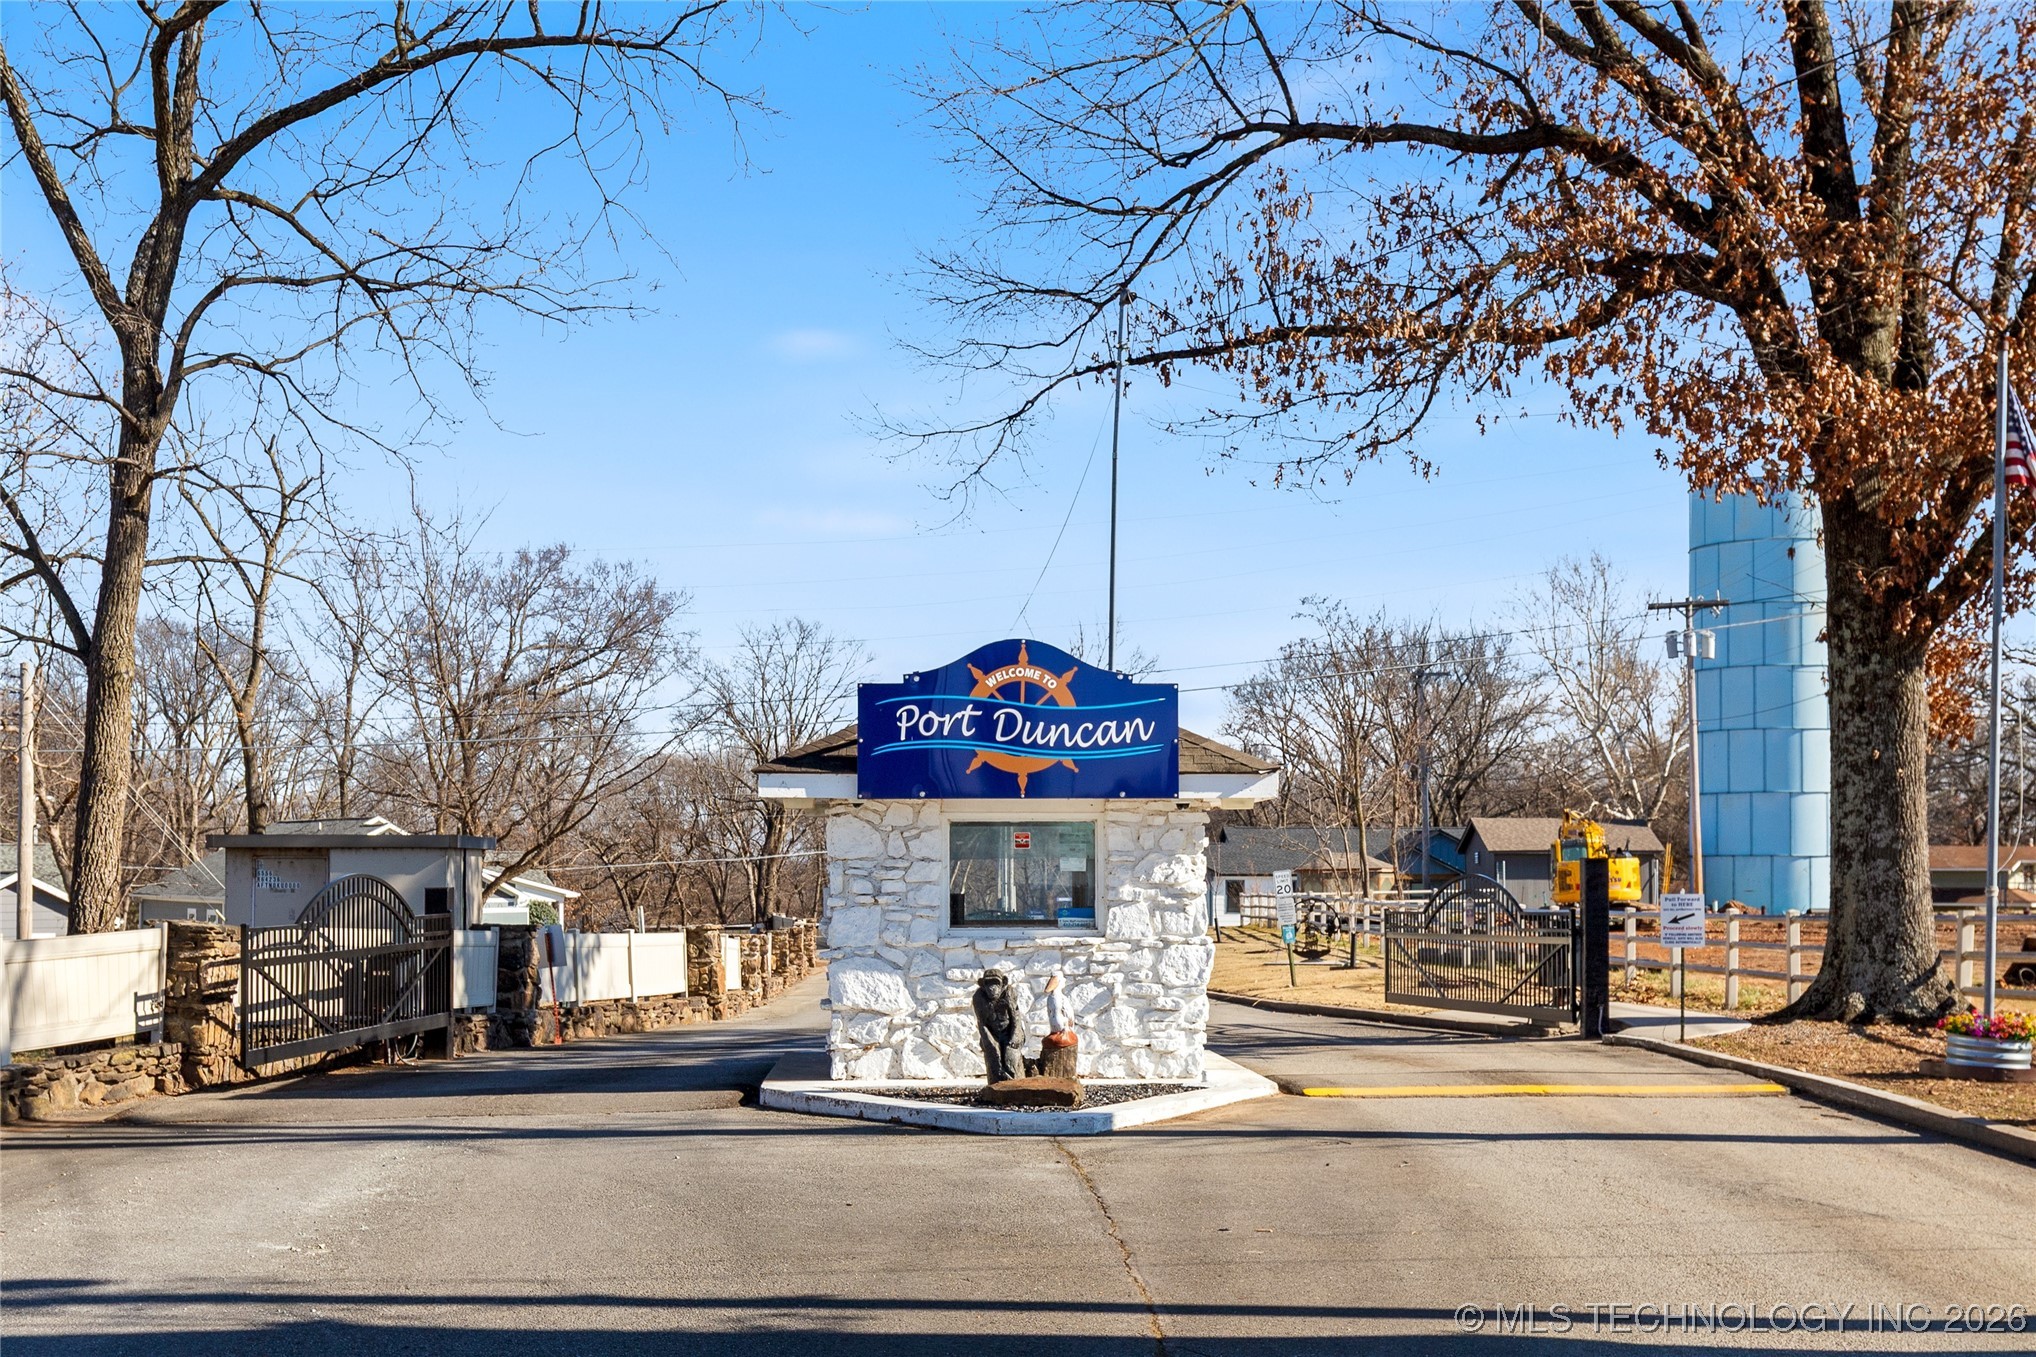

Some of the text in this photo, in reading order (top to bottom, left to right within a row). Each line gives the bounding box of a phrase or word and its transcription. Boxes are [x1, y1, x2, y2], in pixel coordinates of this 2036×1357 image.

[985, 667, 1057, 689] WELCOME TO
[896, 703, 1155, 748] Port Duncan
[1277, 884, 1291, 894] 20
